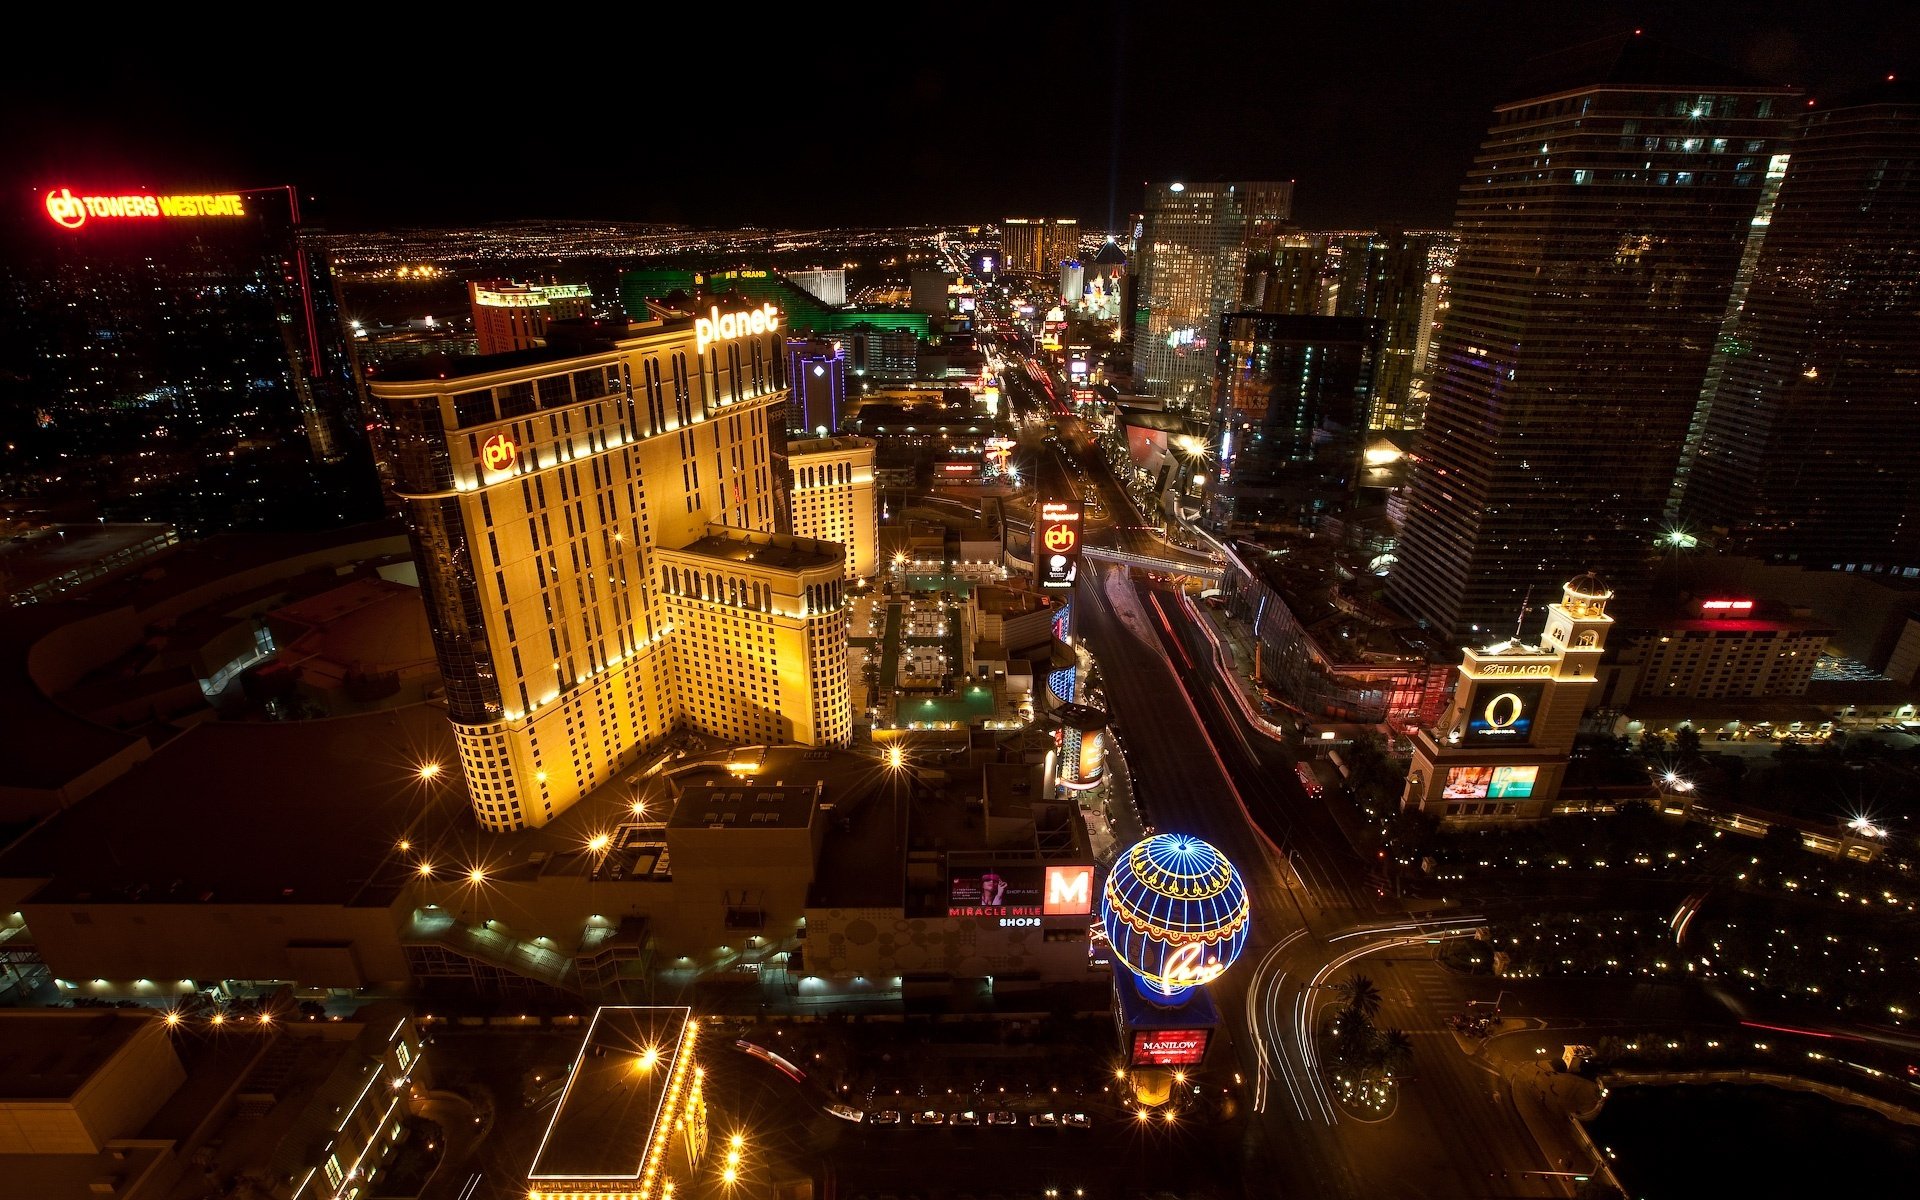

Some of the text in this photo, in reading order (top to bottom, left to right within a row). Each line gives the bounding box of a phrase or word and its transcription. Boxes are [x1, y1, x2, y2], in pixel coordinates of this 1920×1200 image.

[82, 196, 159, 217] TOWERS
[157, 195, 245, 217] WESTGATE
[695, 303, 779, 354] planet
[483, 434, 516, 471] ph
[1045, 524, 1075, 552] ph
[1479, 664, 1551, 675] BELLAGIO
[1485, 693, 1522, 728] O
[1050, 871, 1088, 904] M
[950, 907, 1041, 916] MIRACLE MILE
[1000, 918, 1041, 926] SHOPS
[1162, 941, 1224, 996] Paris
[1143, 1042, 1197, 1050] MANILOW
